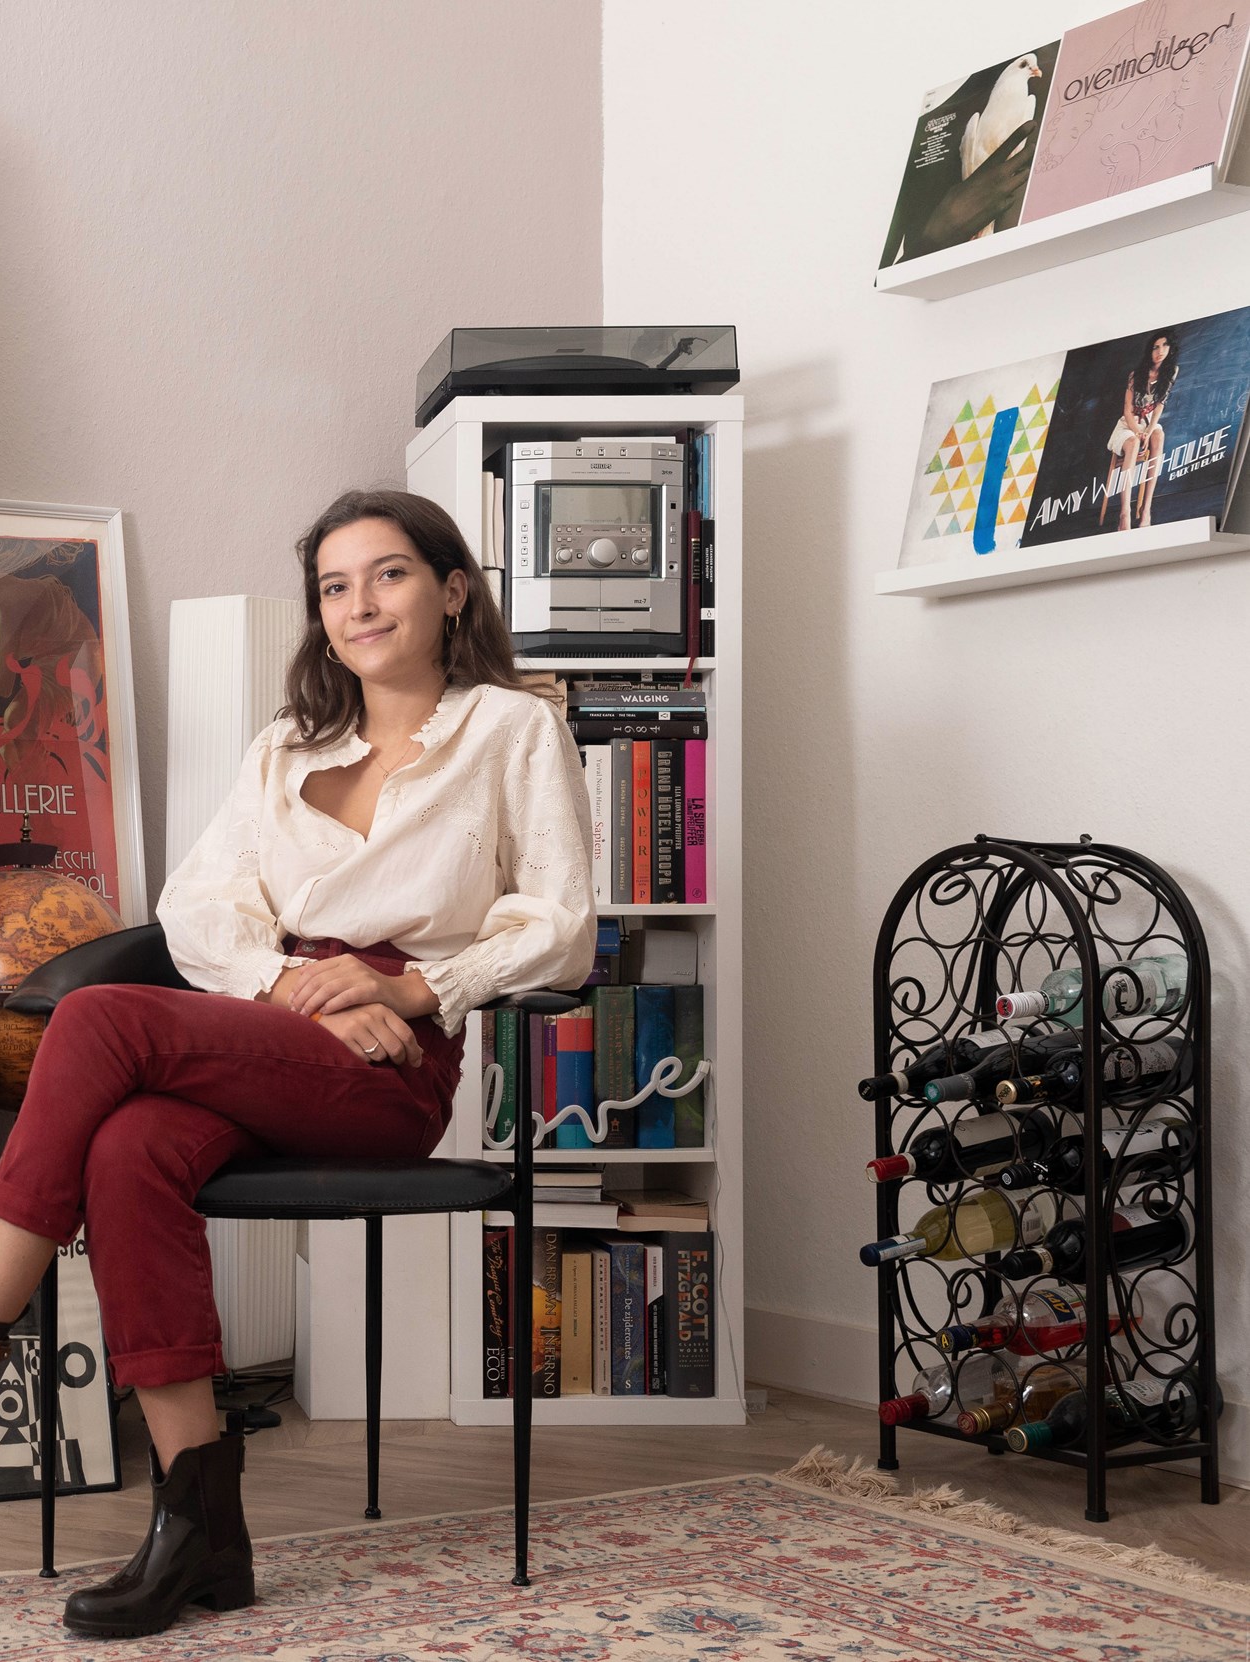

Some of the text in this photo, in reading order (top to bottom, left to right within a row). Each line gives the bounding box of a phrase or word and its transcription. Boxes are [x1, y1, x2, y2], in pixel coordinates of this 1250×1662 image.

[1029, 424, 1232, 532] AMY WINEHOUSE
[1168, 450, 1227, 482] BACK TO BLACK
[620, 695, 670, 703] WALGING
[613, 725, 661, 734] 1984
[657, 751, 673, 885] GRAND HOTEL EUROPA
[692, 798, 704, 810] LA
[593, 821, 605, 860] Sapiens
[692, 1250, 708, 1267] F.
[540, 1233, 560, 1395] DAN BROWN INFERNO
[624, 1298, 633, 1309] De
[677, 1250, 691, 1342] FITZGERALD
[691, 1271, 709, 1340] SCOTT
[621, 1311, 633, 1360] zijderoutes
[486, 1347, 500, 1382] ECO
